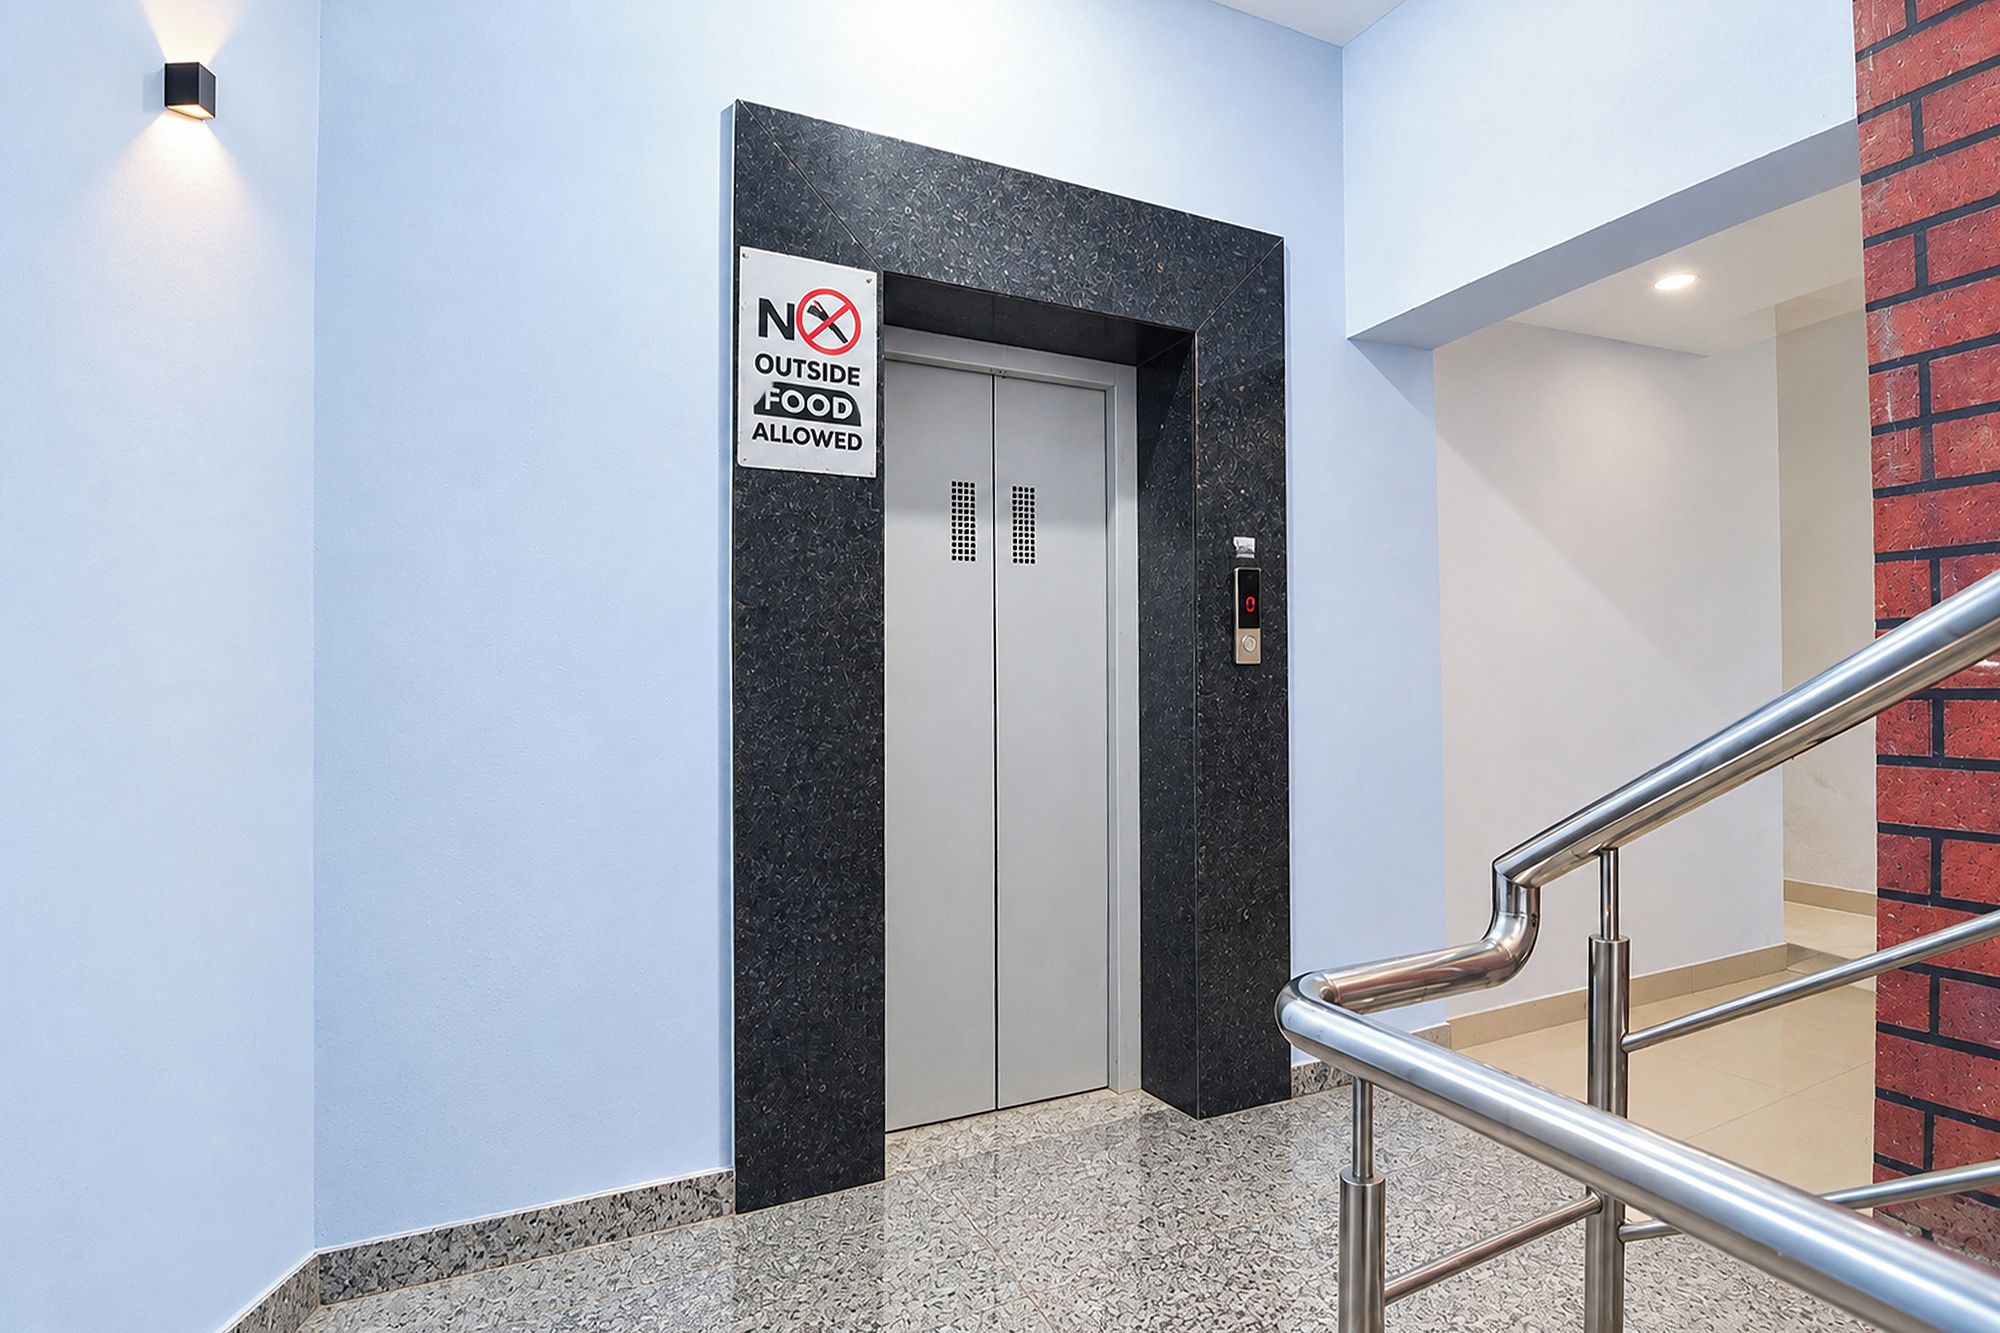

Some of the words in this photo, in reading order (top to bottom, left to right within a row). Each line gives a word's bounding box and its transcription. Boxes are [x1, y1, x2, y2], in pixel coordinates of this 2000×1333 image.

[755, 353, 860, 386] OUTSIDE
[764, 388, 853, 420] FOOD
[752, 422, 862, 451] ALLOWED
[1245, 595, 1256, 612] 0
